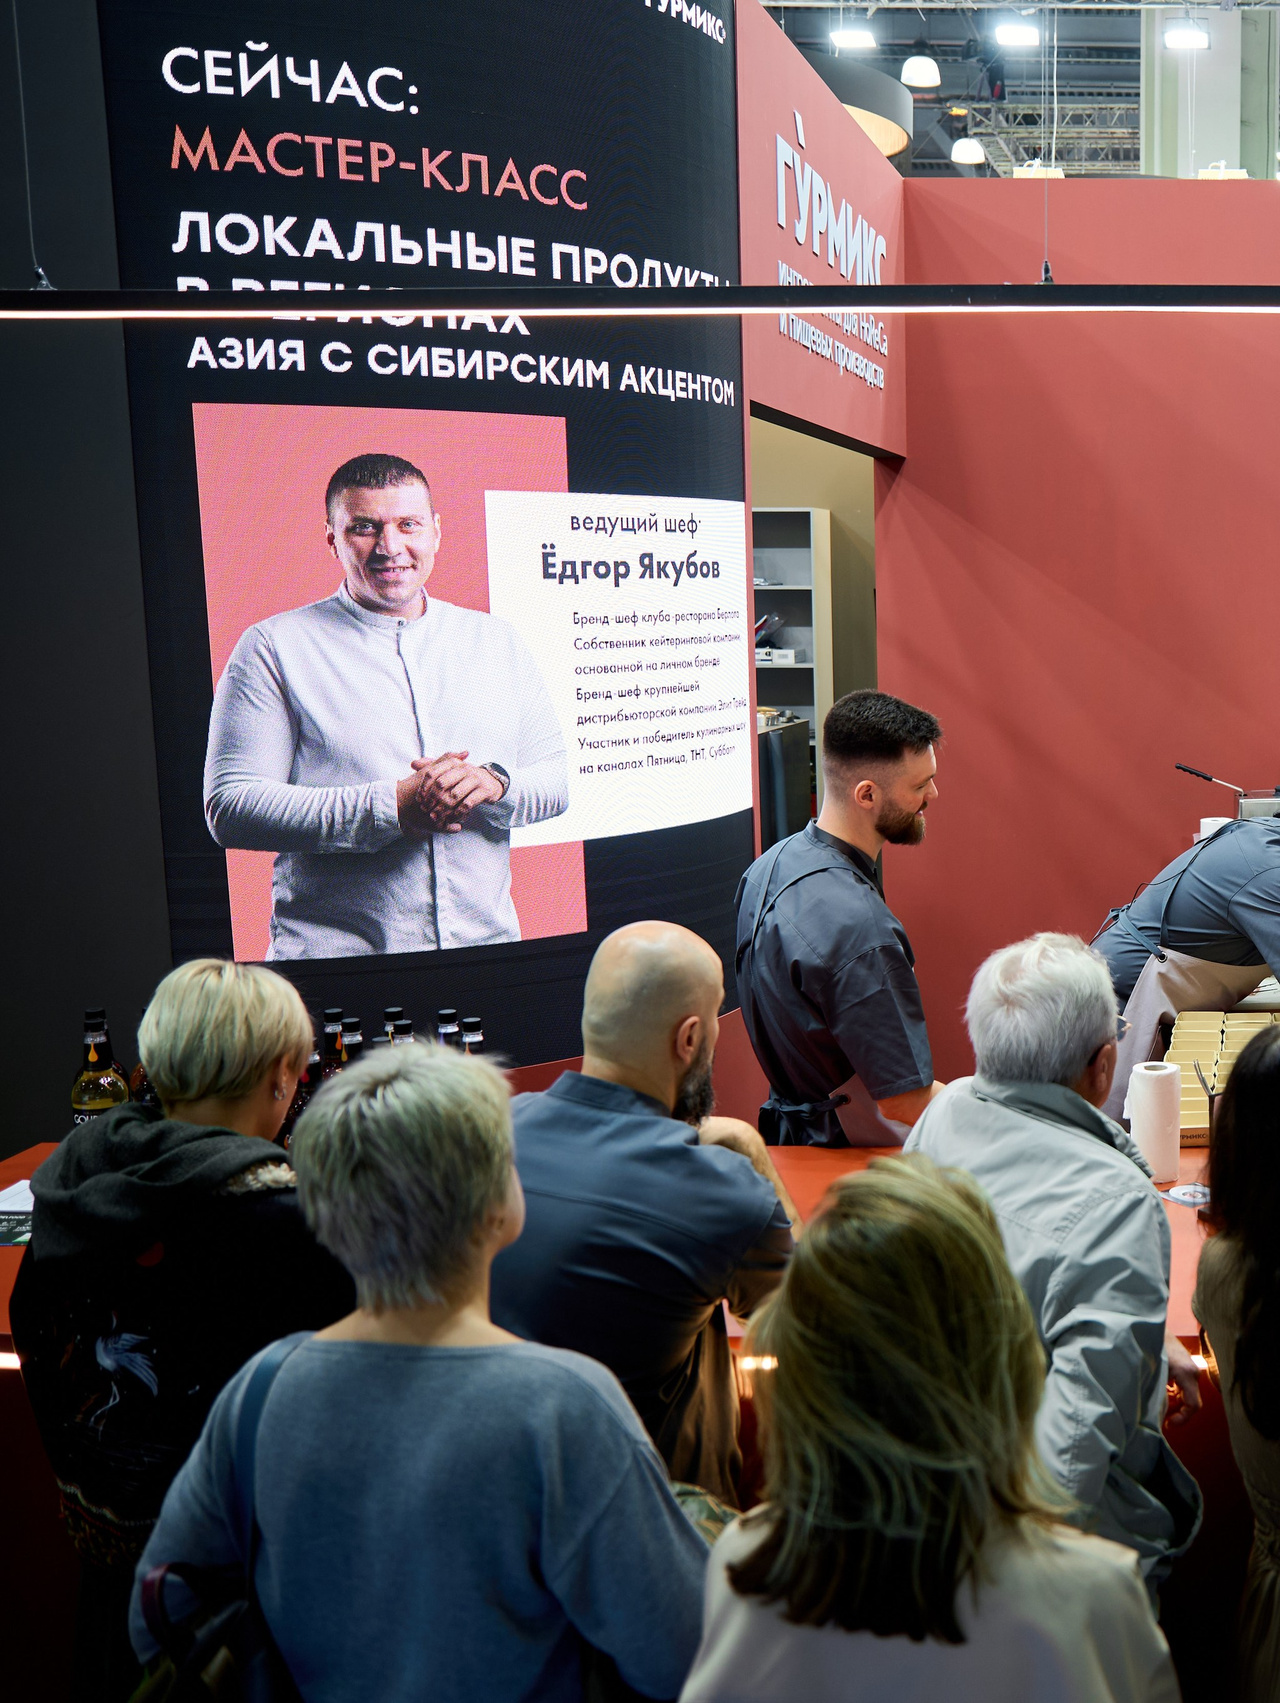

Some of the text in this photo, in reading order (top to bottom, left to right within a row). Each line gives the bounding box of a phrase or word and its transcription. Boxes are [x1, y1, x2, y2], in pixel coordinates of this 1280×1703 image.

[161, 41, 419, 115] СЕЙЧАС:
[170, 125, 588, 210] МАСТЕР-КЛАСС
[171, 211, 537, 276] ЛОКАЛЬНЫЕ
[788, 313, 834, 361] пищевых
[834, 340, 885, 390] производств
[187, 336, 735, 407] АЗИЯ С СИБИРСКИМ АКЦЕНТОМ
[570, 512, 659, 538] ведущий
[541, 543, 720, 588] Ёдгор Якубов
[573, 637, 647, 651] Собственник
[649, 633, 712, 650] кейтеринговой
[574, 655, 721, 675] основанной на личном бренде
[644, 681, 700, 698] крупнейшей
[576, 706, 677, 726] дистрибьюторской
[577, 737, 631, 750] Участник
[633, 735, 640, 745] и
[642, 730, 695, 745] победитель
[579, 764, 594, 774] на
[597, 759, 644, 773] каналах
